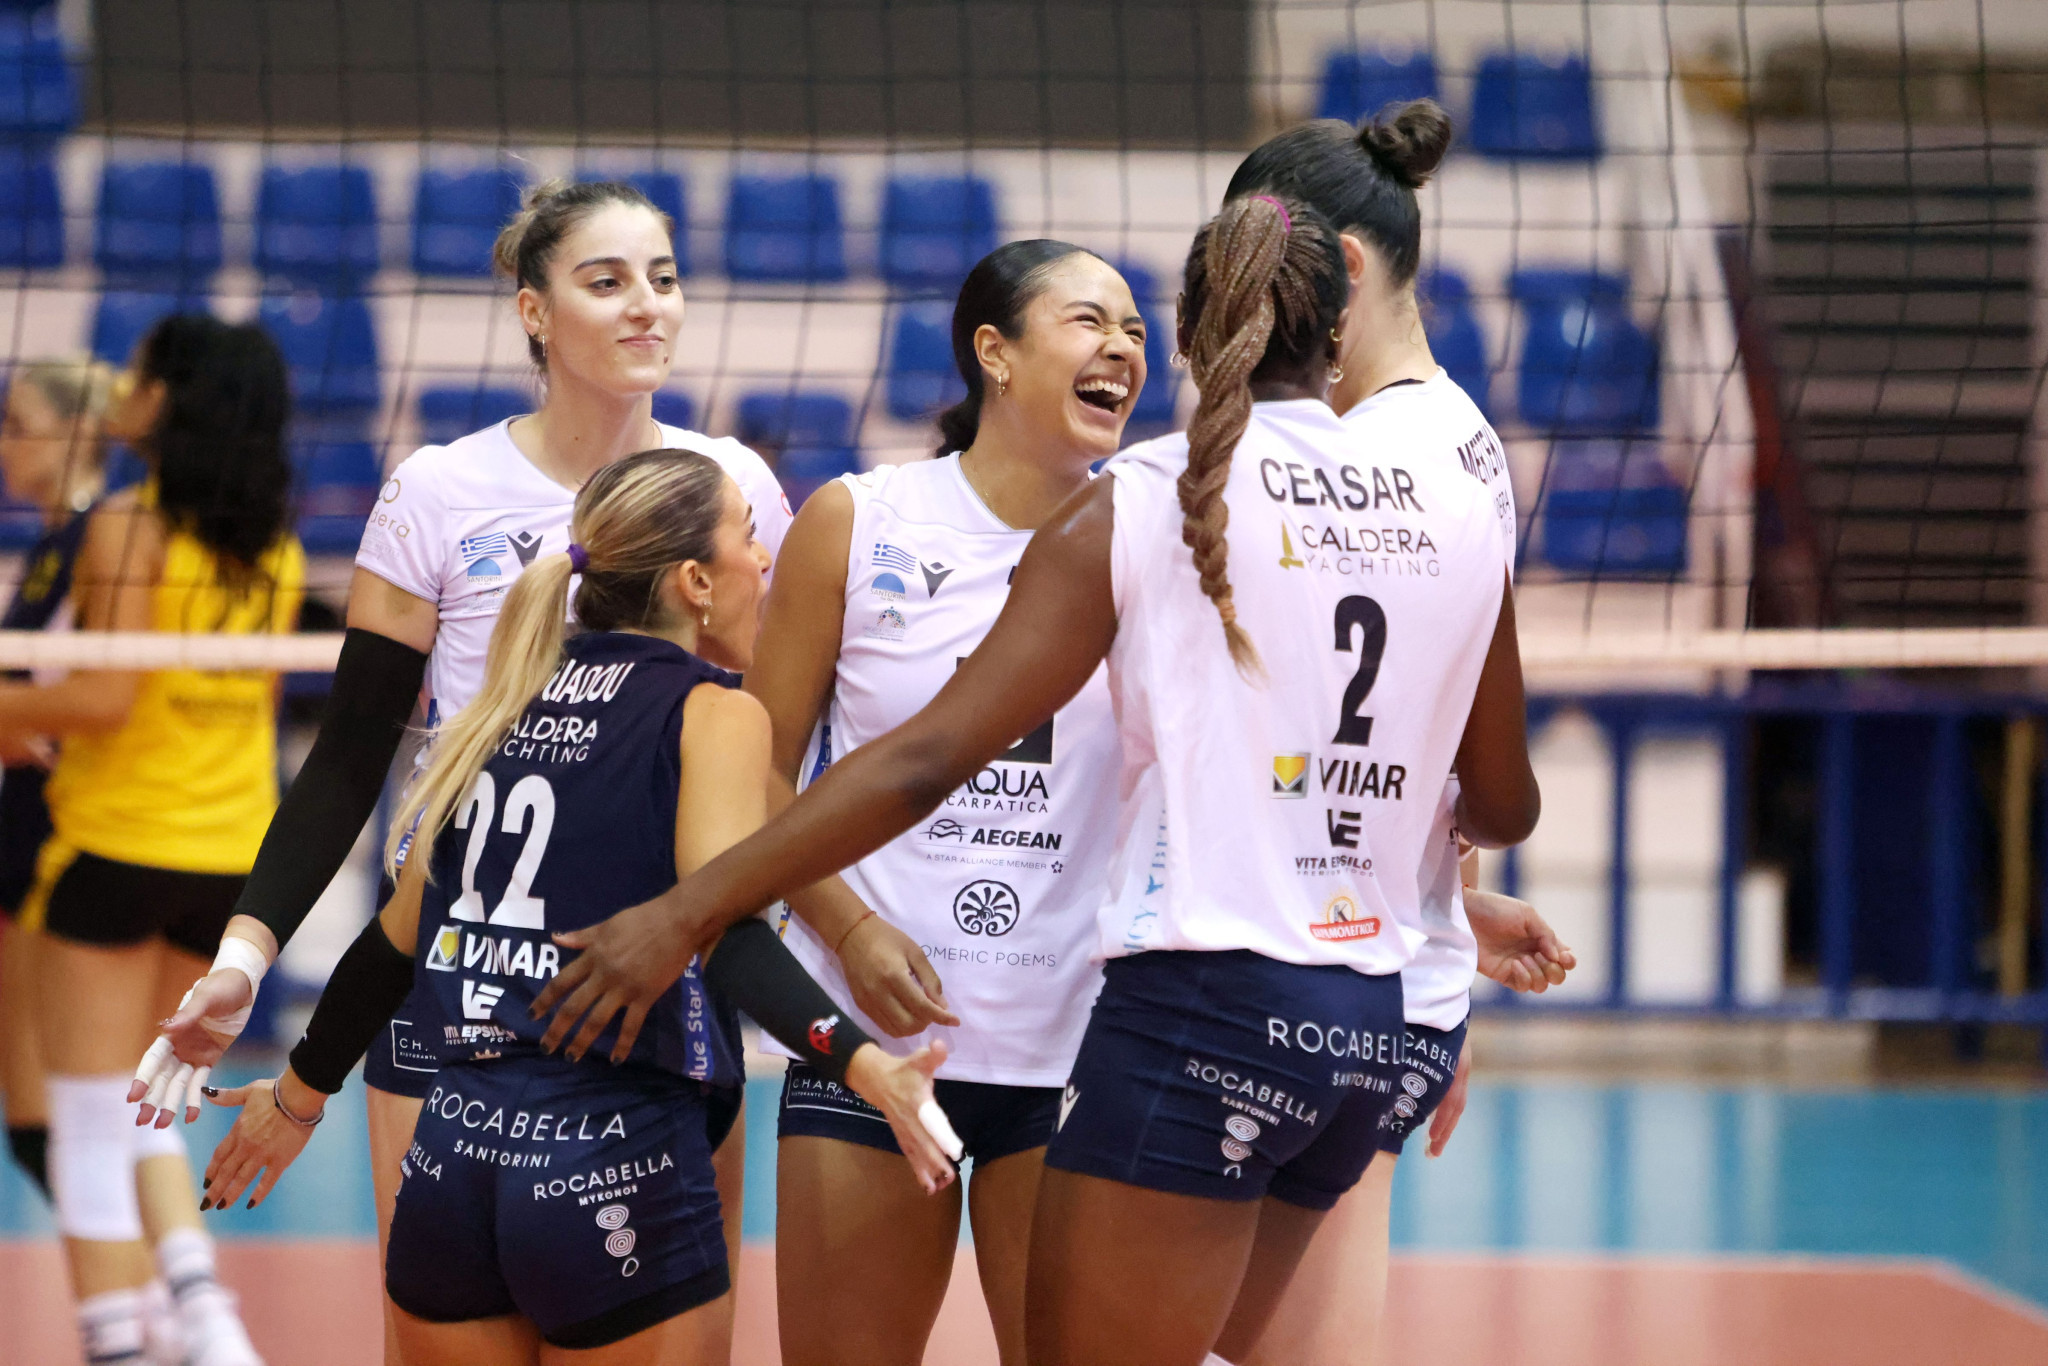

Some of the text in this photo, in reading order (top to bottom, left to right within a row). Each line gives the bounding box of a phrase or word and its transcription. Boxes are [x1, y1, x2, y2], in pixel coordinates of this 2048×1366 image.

[1261, 458, 1425, 512] CEASAR
[1302, 525, 1437, 553] CALDERA
[1305, 555, 1440, 577] YACHTING
[870, 588, 906, 600] SANTORINI
[1331, 594, 1387, 747] 2
[504, 740, 590, 763] CHTING
[946, 795, 1048, 813] CARPATICA
[449, 771, 556, 930] 22
[970, 828, 1062, 850] AEGEAN
[934, 854, 958, 863] STAR
[960, 857, 1004, 867] ALLIANCE
[1007, 860, 1047, 870] MEMBER
[1295, 857, 1327, 869] VITA
[995, 952, 1056, 967] POEMS
[688, 986, 703, 1032] Star
[689, 1041, 708, 1080] lue
[1185, 1059, 1318, 1127] ROCABELLA
[427, 1086, 625, 1140] ROCABELLA
[1221, 1096, 1280, 1126] SANTORINI
[454, 1139, 550, 1168] SANTORINI
[534, 1153, 674, 1200] ROCABELLA
[578, 1185, 638, 1206] MYKONOS
